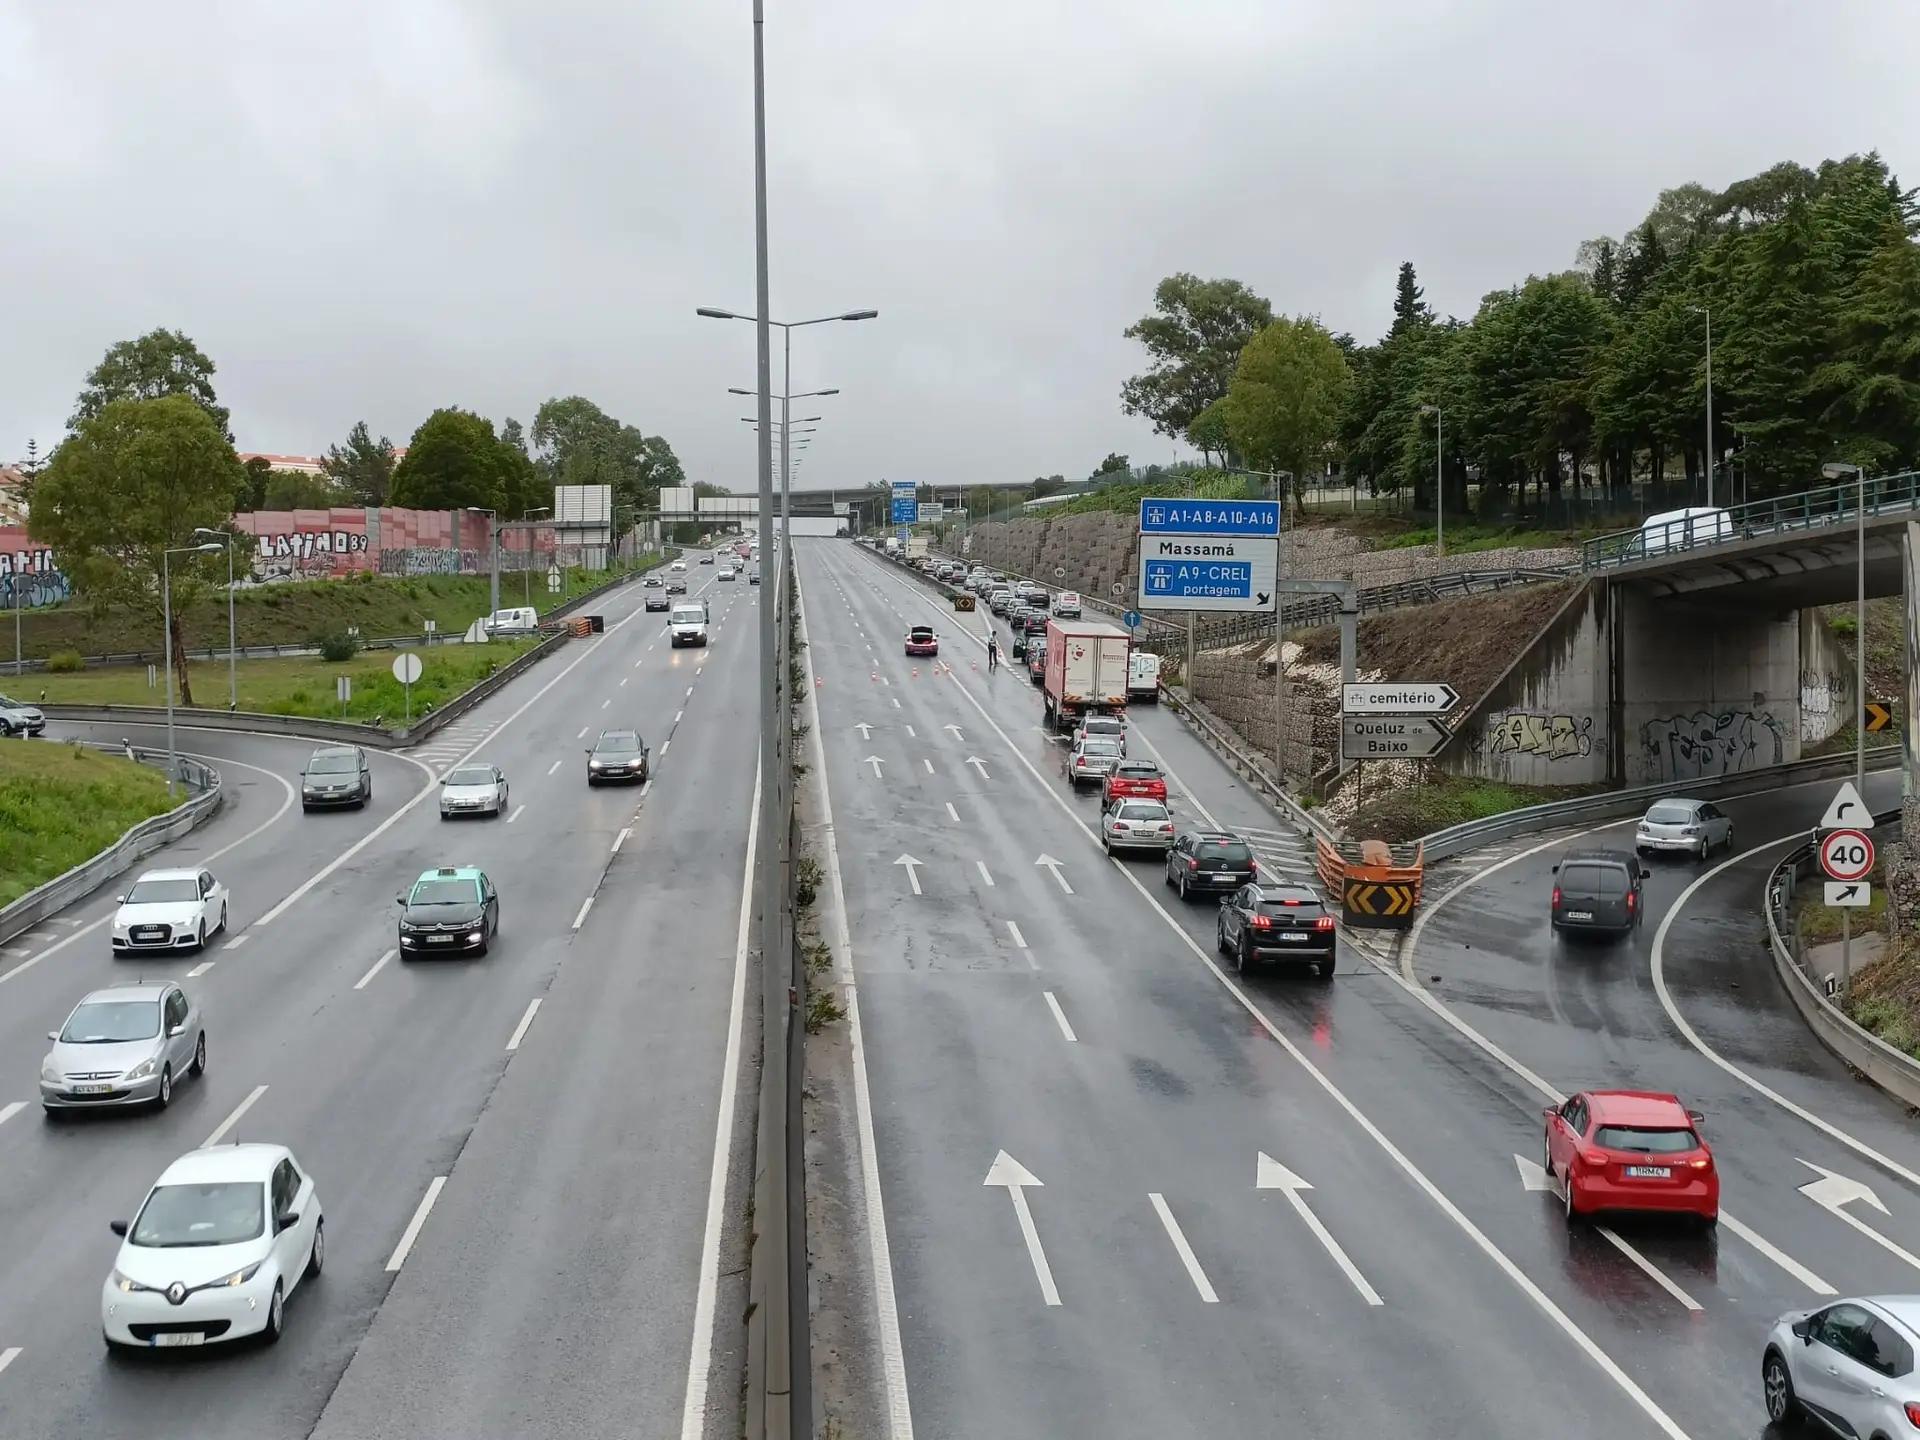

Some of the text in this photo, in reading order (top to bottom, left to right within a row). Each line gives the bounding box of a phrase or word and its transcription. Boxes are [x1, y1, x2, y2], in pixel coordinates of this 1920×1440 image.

[1160, 542, 1234, 556] Massamá
[1183, 585, 1241, 597] portagem
[1369, 692, 1436, 704] cemitério
[1354, 723, 1405, 735] Queluz
[1368, 740, 1408, 752] Baixo
[1830, 845, 1866, 865] 40
